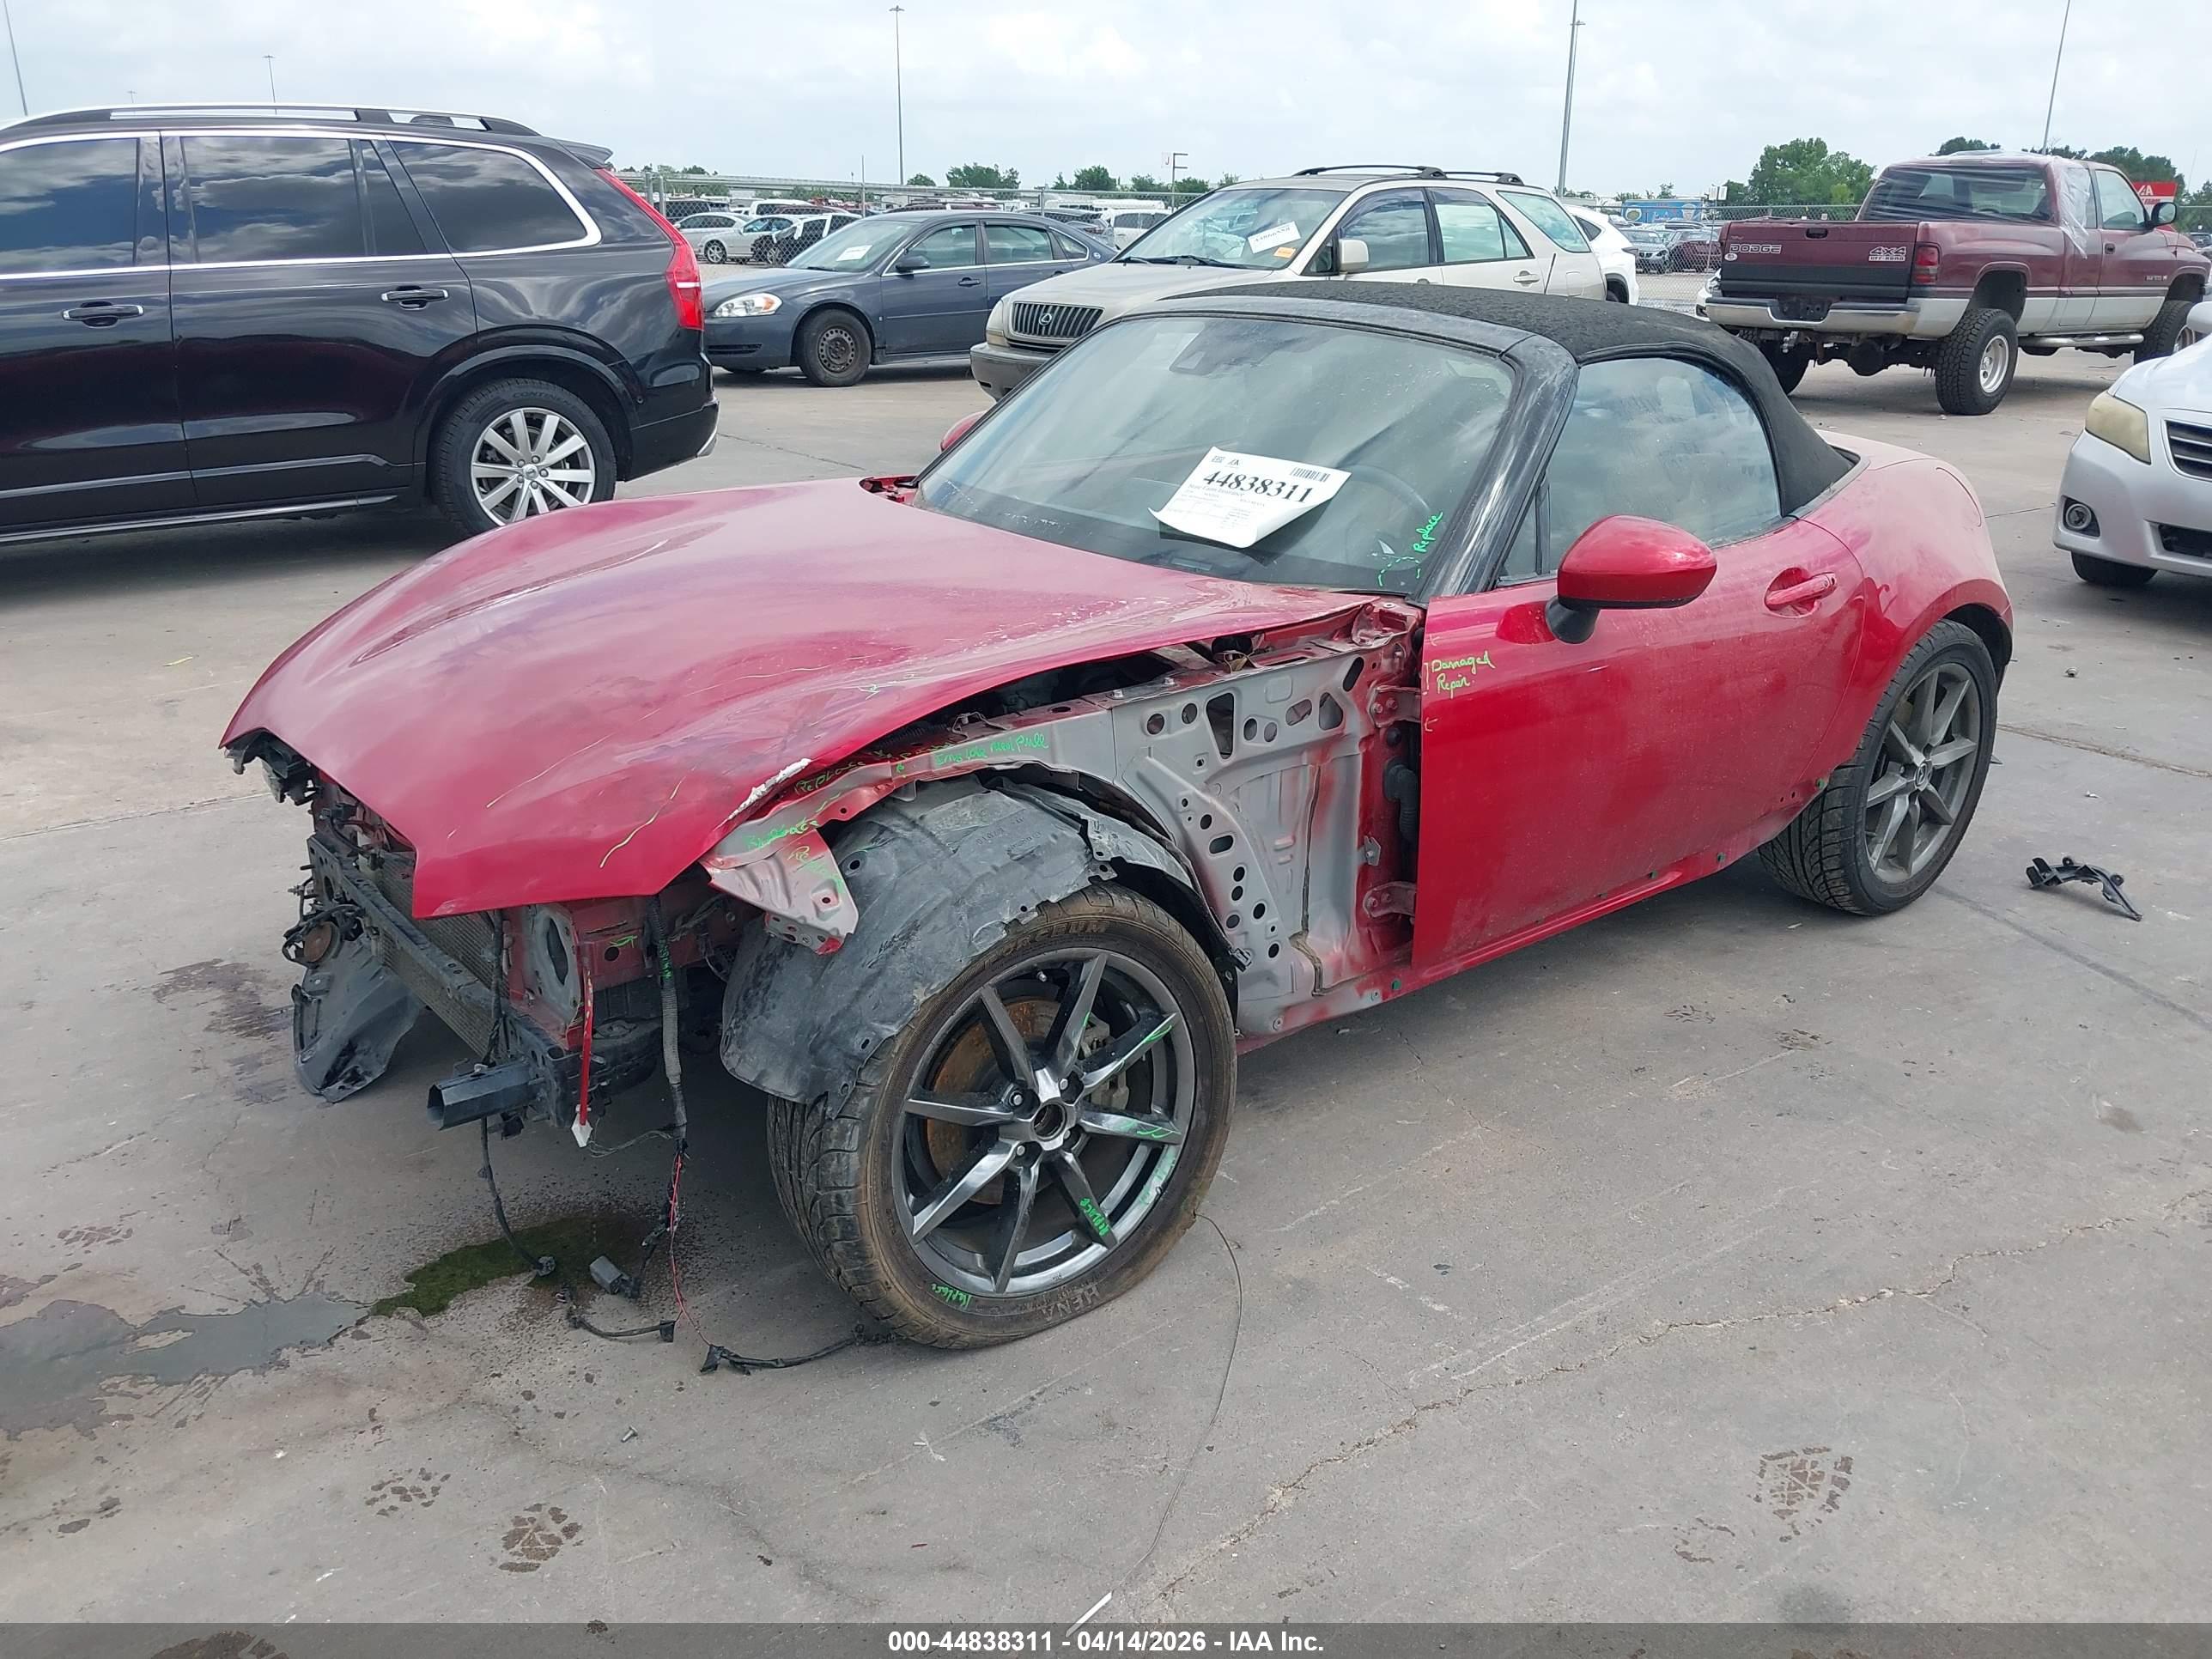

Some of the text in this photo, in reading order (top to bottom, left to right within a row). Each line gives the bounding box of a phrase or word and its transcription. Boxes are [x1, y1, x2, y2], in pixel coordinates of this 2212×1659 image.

[1729, 243, 1783, 254] DODGE
[1203, 471, 1314, 503] 44838311
[1413, 512, 1443, 552] Replace
[1431, 650, 1496, 674] Damaged
